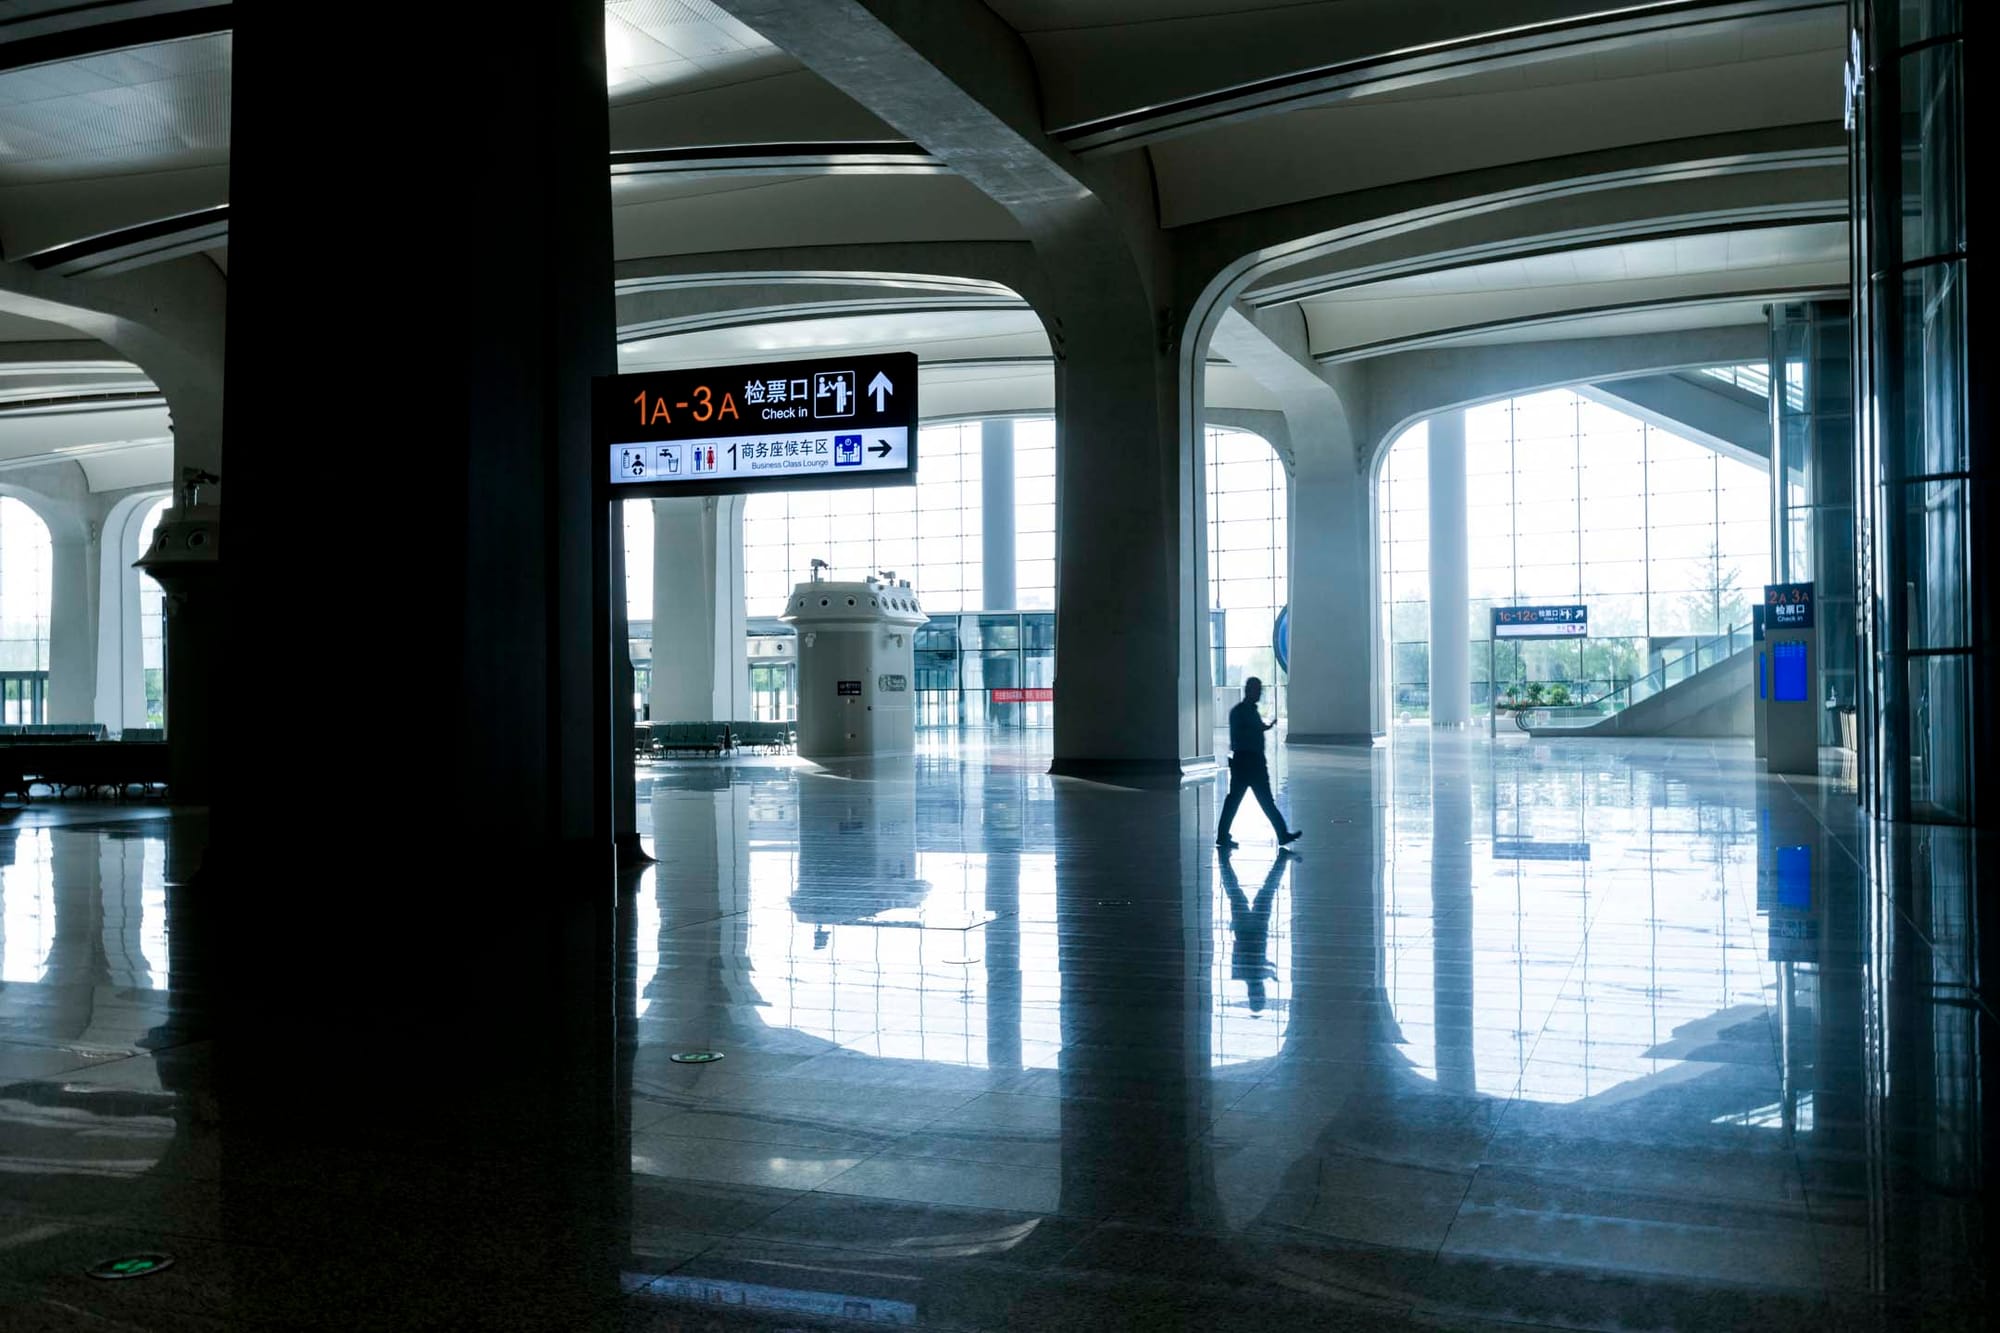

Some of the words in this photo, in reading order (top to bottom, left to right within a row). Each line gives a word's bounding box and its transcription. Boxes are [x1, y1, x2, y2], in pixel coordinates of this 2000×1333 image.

[744, 379, 808, 405] 检票口
[761, 407, 796, 420] Check
[797, 406, 808, 418] in
[741, 438, 828, 459] 商务座候车区
[751, 460, 781, 470] Business
[782, 459, 802, 468] Class
[803, 459, 829, 468] Lounge
